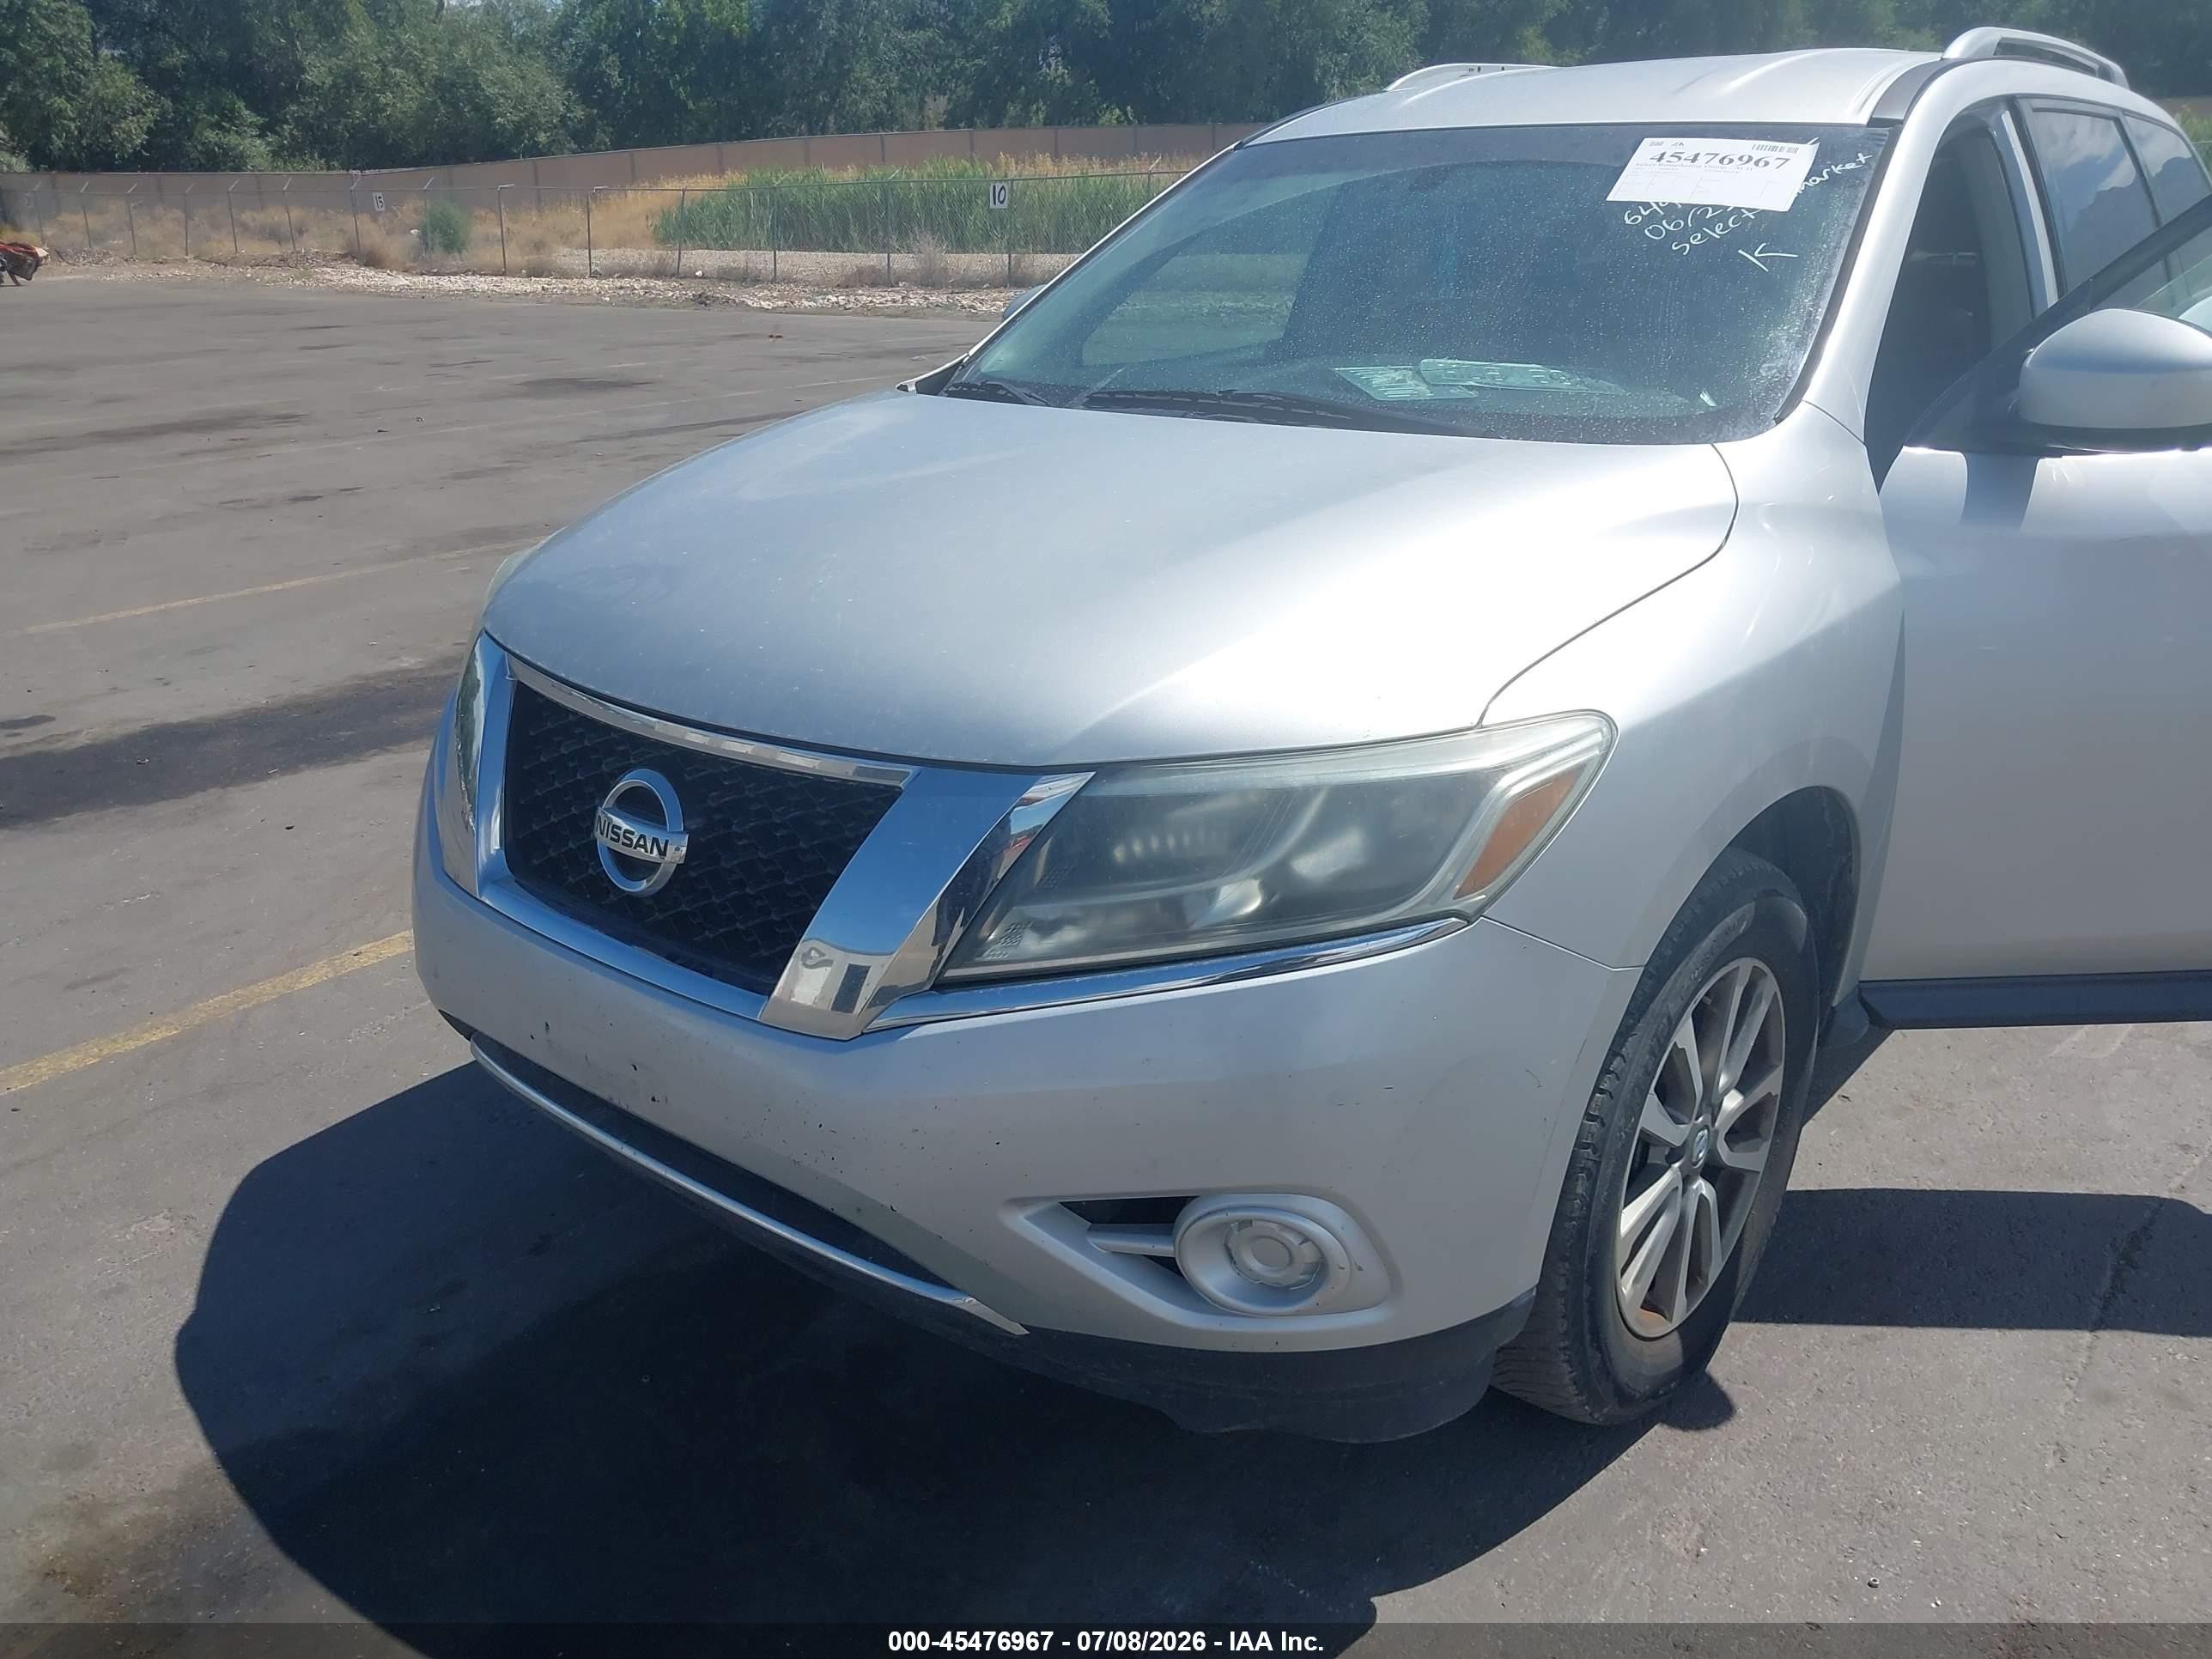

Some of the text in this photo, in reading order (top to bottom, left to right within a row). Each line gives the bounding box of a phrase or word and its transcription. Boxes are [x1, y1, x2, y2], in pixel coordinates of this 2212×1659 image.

[1649, 151, 1791, 169] 45476967
[992, 185, 1007, 206] 10
[595, 815, 671, 857] NISSAN
